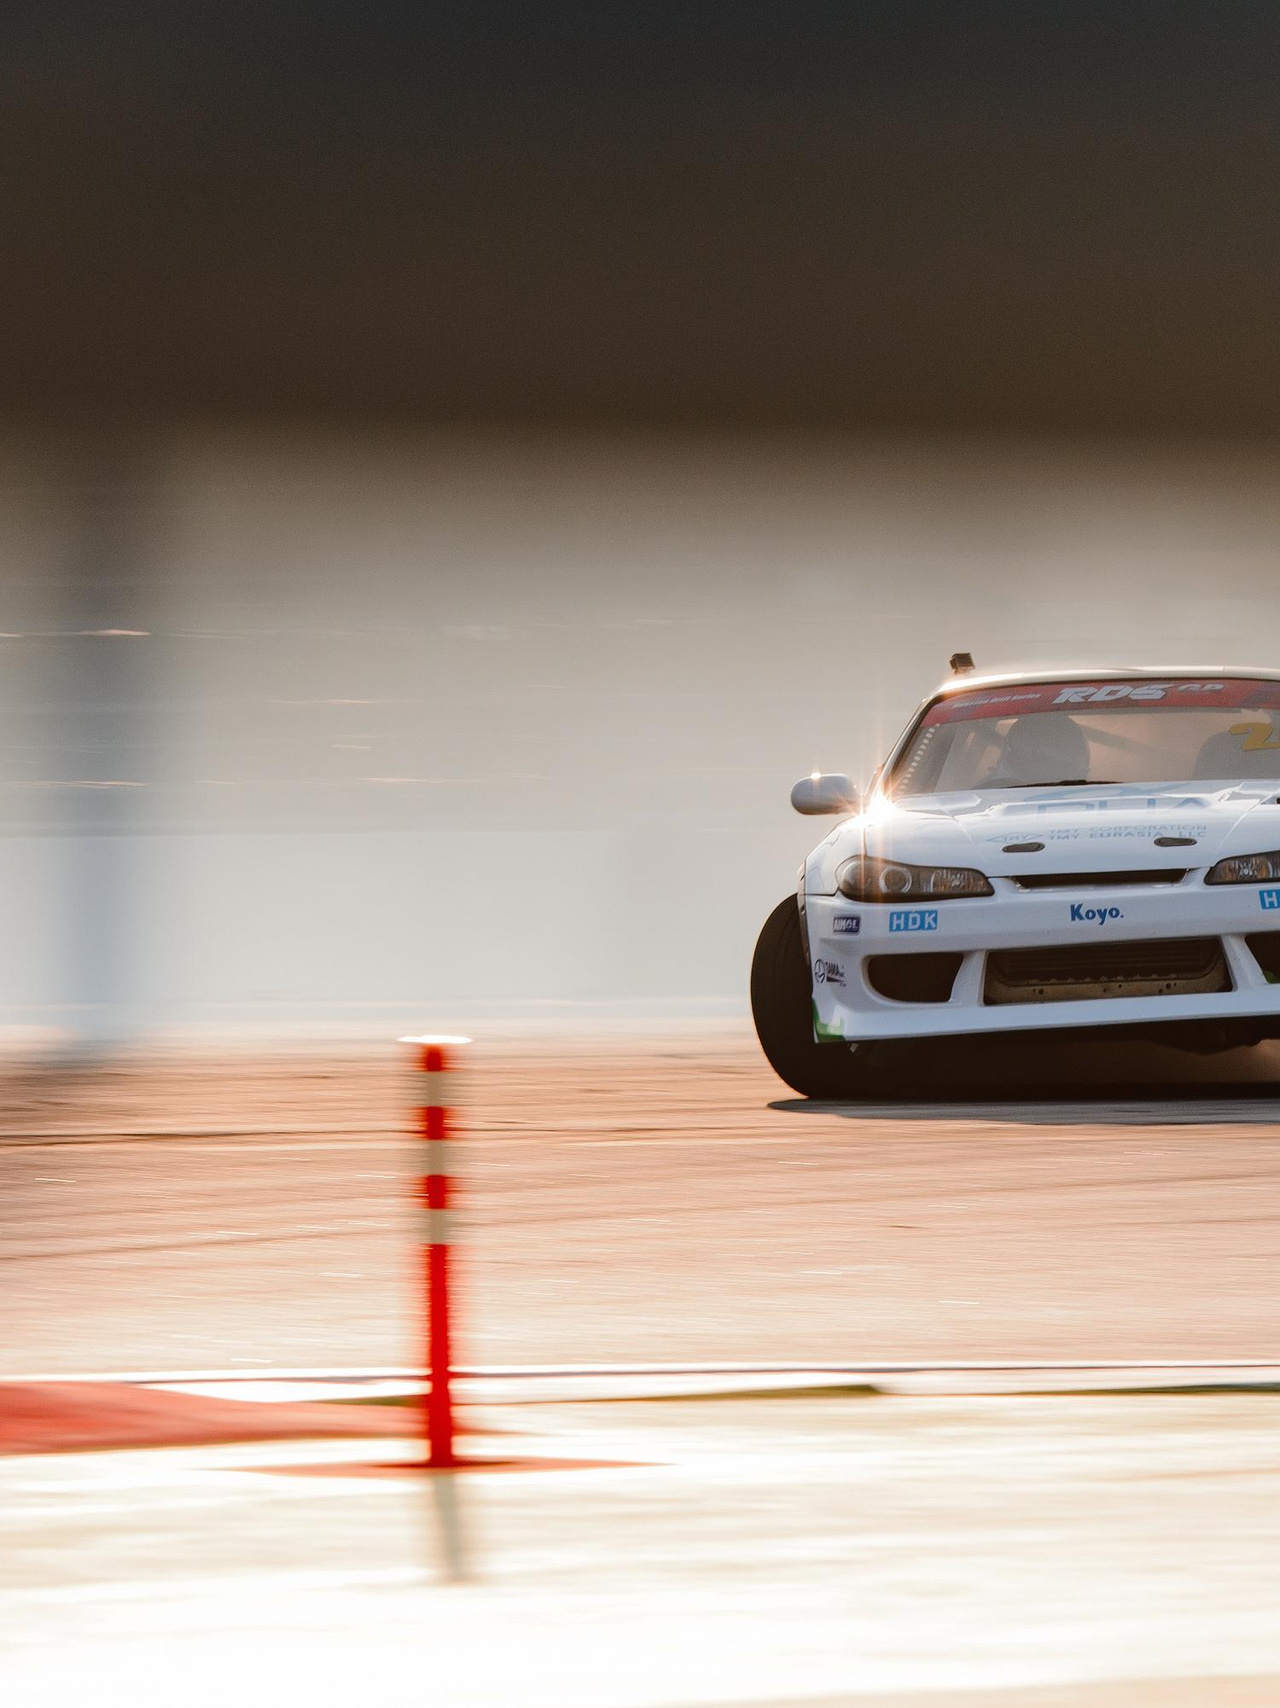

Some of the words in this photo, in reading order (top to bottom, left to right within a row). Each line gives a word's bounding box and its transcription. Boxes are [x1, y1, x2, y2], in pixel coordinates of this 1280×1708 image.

[1051, 683, 1175, 704] RDS
[1089, 831, 1164, 839] EURASIA
[892, 911, 937, 931] HDK
